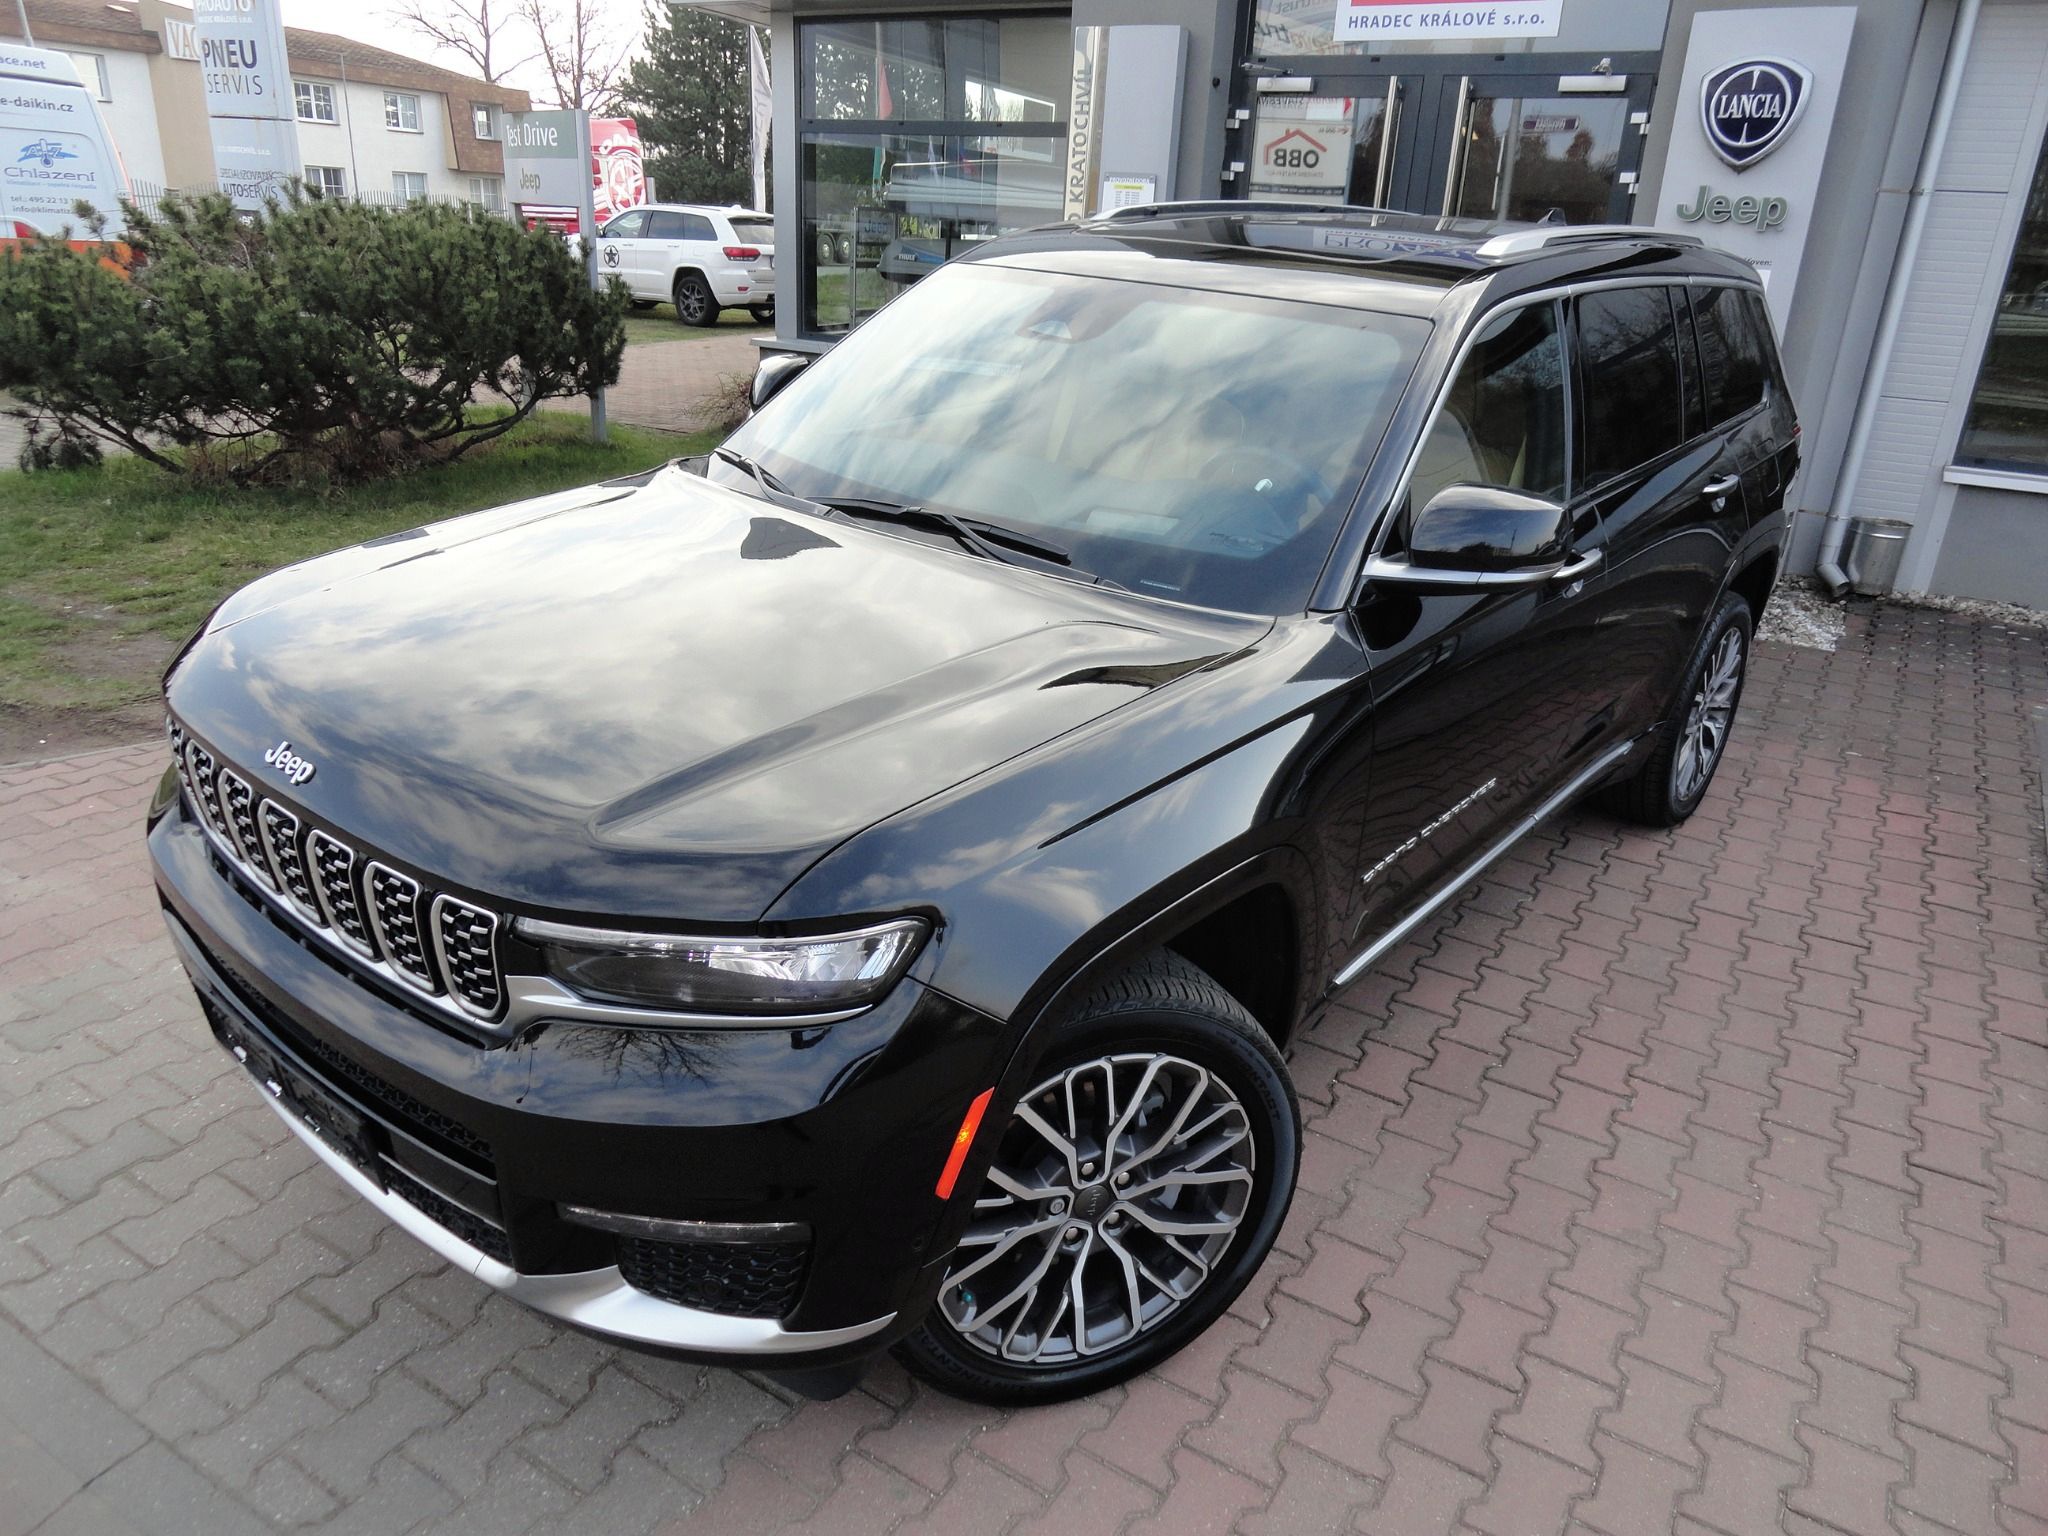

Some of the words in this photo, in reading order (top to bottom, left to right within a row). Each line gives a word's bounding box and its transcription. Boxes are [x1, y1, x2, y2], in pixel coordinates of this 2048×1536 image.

[1348, 14, 1413, 29] HRADEC
[1419, 9, 1497, 27] KRÁLOVÉ
[1503, 13, 1545, 25] s.r.o.
[201, 39, 257, 69] PNEU
[207, 74, 263, 95] SERVIS
[1717, 93, 1781, 119] LANCIA
[506, 124, 521, 148] Test
[523, 121, 558, 147] Drive
[1069, 67, 1092, 203] KRATOCHVÍL
[4, 166, 96, 182] Chlazení
[519, 167, 541, 194] Jeep
[222, 183, 279, 200] AUTOSERVIS
[13, 206, 76, 216] info@klimatiz
[1676, 184, 1789, 232] Jeep
[264, 740, 317, 786] Jeep
